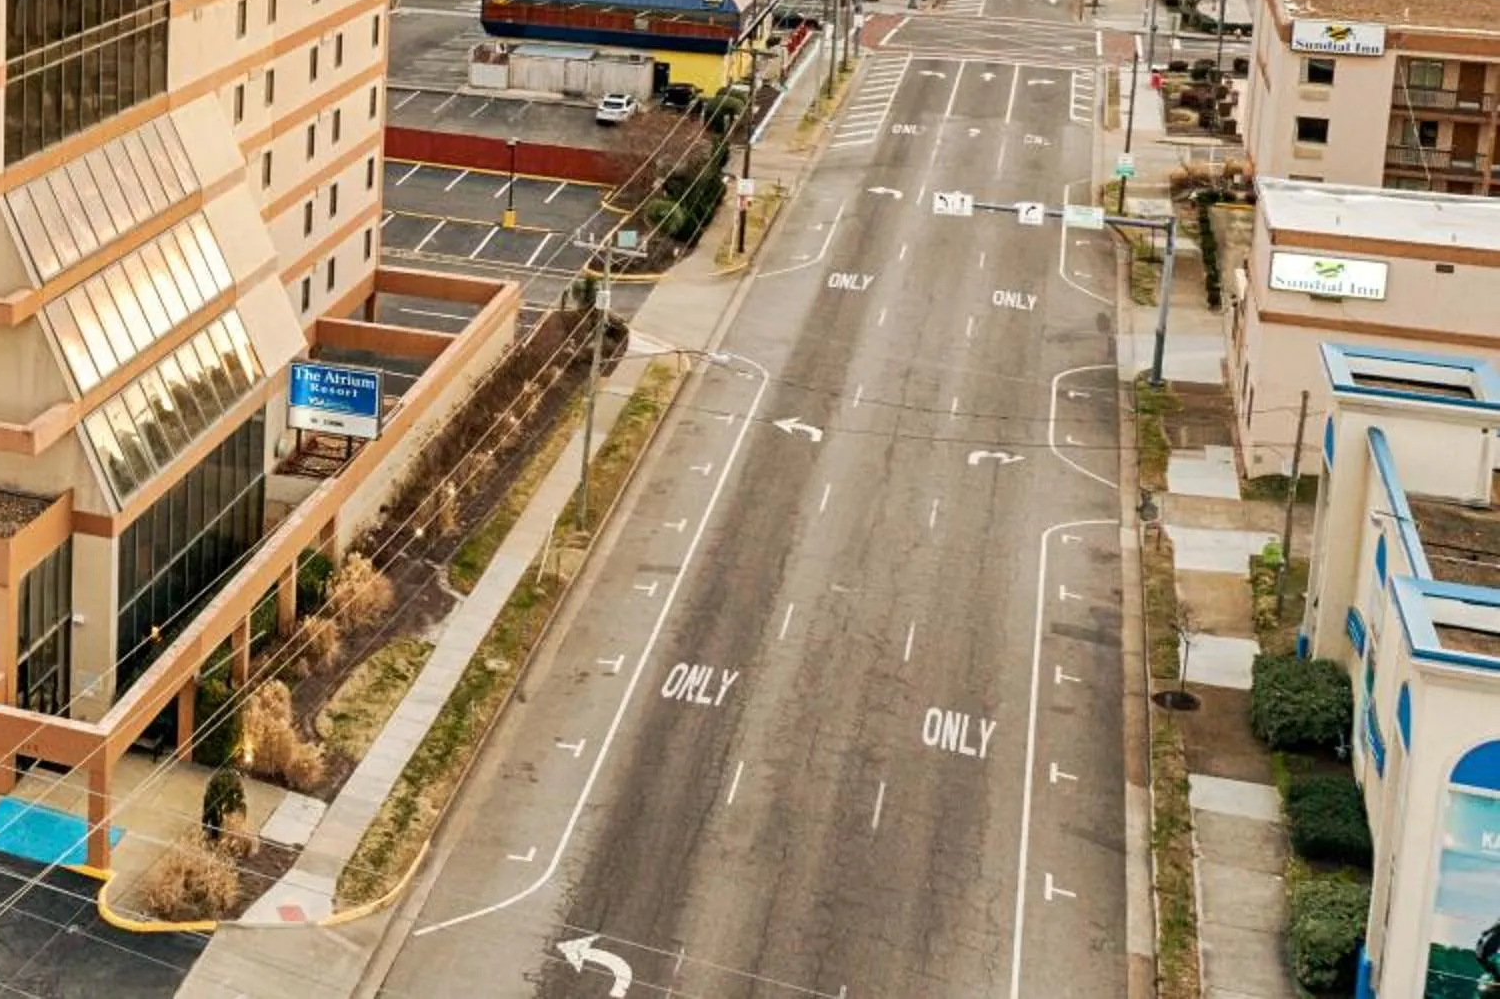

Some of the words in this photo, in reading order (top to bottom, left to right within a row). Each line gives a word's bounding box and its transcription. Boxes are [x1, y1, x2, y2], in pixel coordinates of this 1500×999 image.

[827, 272, 874, 290] ONLY
[992, 290, 1038, 312] ONLY
[293, 366, 321, 382] The
[324, 371, 375, 390] Atrium
[311, 382, 358, 398] Resort
[661, 662, 740, 707] ONLY
[922, 707, 997, 759] ONLY
